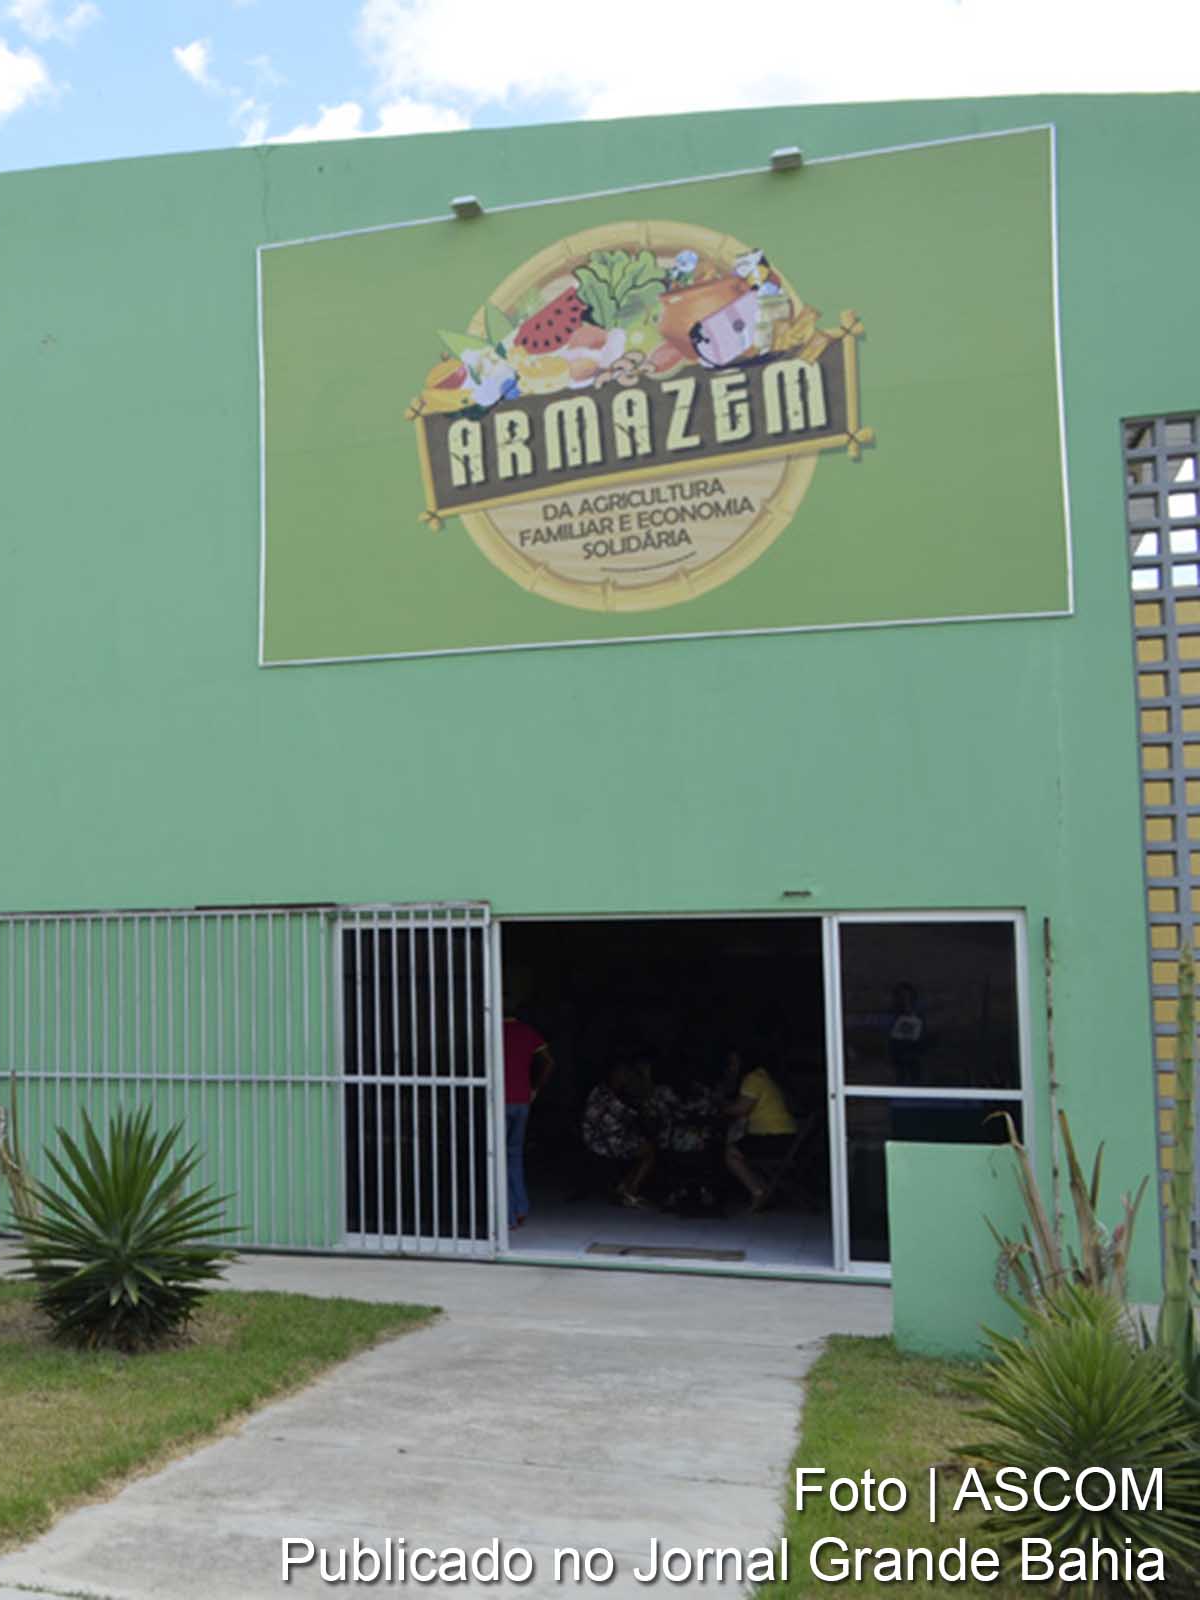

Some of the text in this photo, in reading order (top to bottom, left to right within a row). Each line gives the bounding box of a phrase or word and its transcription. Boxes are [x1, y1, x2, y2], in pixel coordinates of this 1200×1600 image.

[518, 495, 756, 547] FAMILIAR E ECONOMIA
[542, 477, 726, 522] DA AGRICULTURA
[582, 524, 693, 560] SOLIDÁRIA
